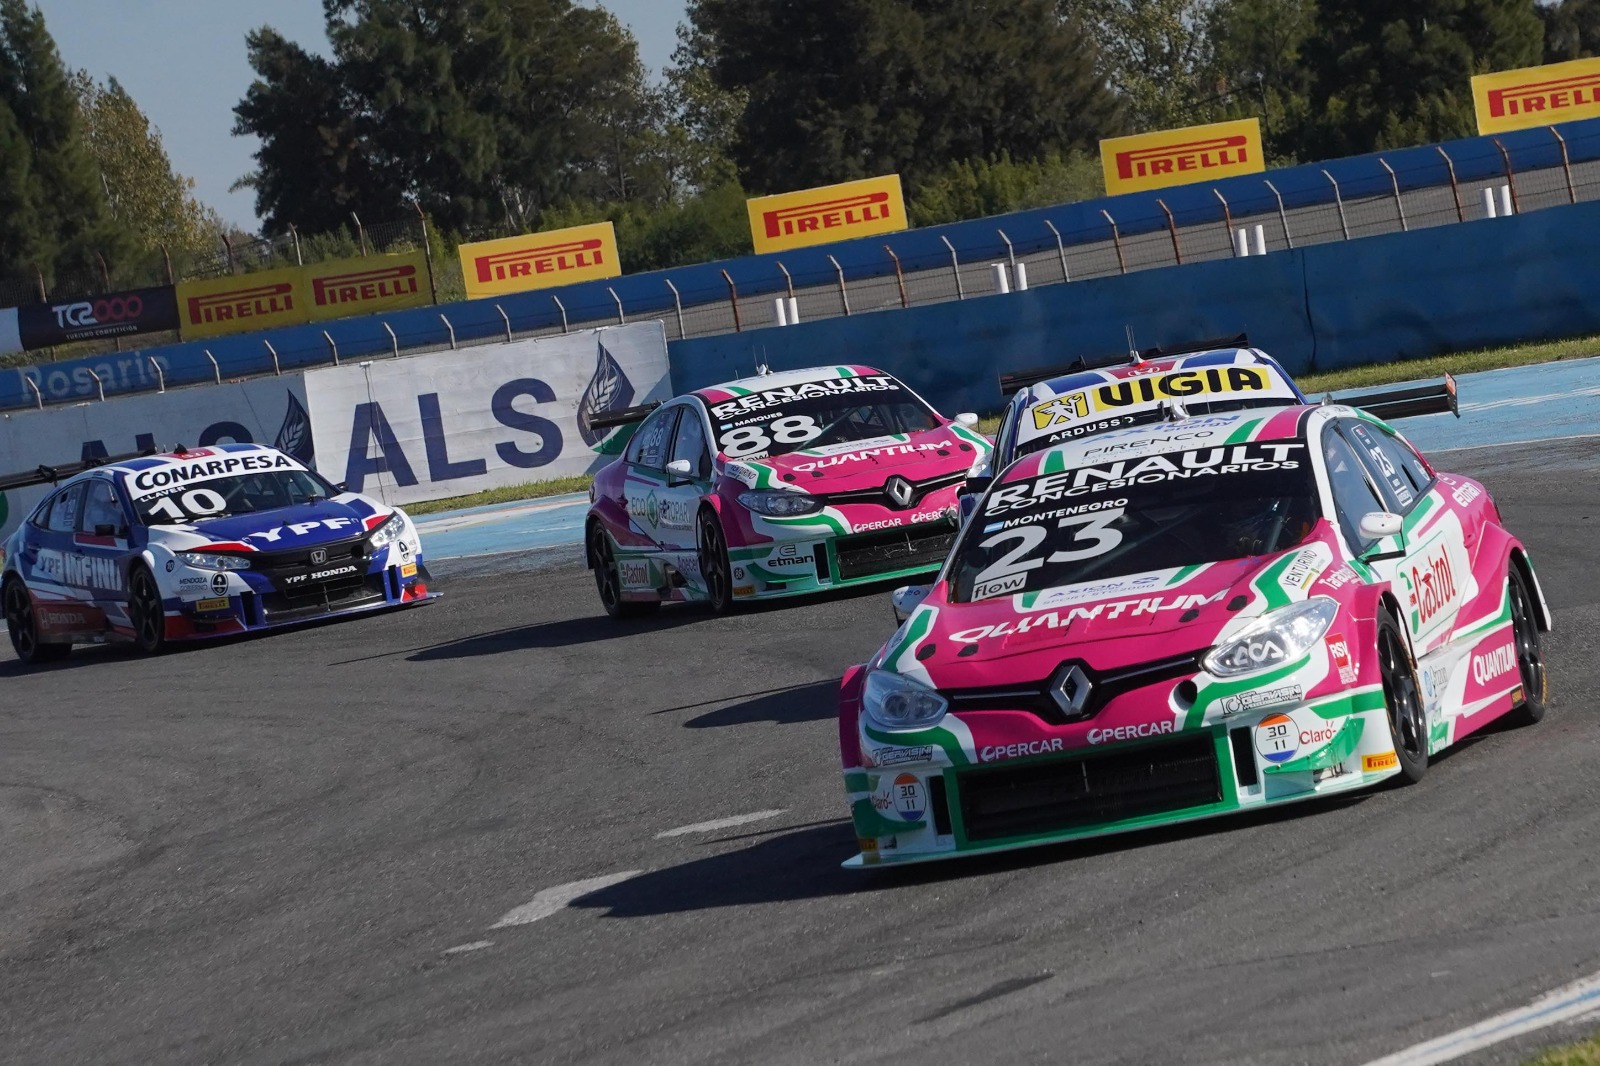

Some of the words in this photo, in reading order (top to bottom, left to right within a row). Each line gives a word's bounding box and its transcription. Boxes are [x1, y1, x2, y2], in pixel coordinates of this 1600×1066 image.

[1116, 136, 1247, 180] PIRELLI
[763, 192, 890, 238] PIRELLI
[475, 239, 603, 283] PIRELLI
[312, 265, 418, 305] PIRELLI
[52, 295, 144, 329] TC2000
[187, 283, 293, 325] PIRELLI
[17, 351, 171, 400] Rosario
[710, 376, 893, 418] RENAULT
[718, 385, 900, 421] CONCESIONARIOS
[720, 416, 823, 459] 88
[735, 412, 783, 427] MARQUES
[792, 440, 953, 472] QUANTIUM
[1084, 431, 1214, 457] PIRENCO
[135, 455, 292, 491] CONARPESA
[984, 461, 1300, 517] CONCESIONARIOS
[989, 443, 1305, 510] RENAULT
[140, 486, 187, 503] LLAVER
[148, 488, 227, 524] 10
[247, 517, 352, 543] YPF
[1003, 498, 1129, 529] MONTENEGRO
[768, 556, 814, 567] etman
[974, 508, 1125, 584] 23
[180, 577, 208, 585] MENDOZA
[285, 574, 308, 584] YPF
[311, 565, 358, 579] HONDA
[973, 575, 1025, 599] flow
[1412, 543, 1456, 624] Castrol
[948, 588, 1232, 644] QUANTIUM
[1473, 642, 1517, 687] QUANTIUM
[1267, 724, 1287, 738] 30
[1274, 739, 1286, 751] 11
[1300, 727, 1333, 745] Claro
[900, 785, 915, 797] 30
